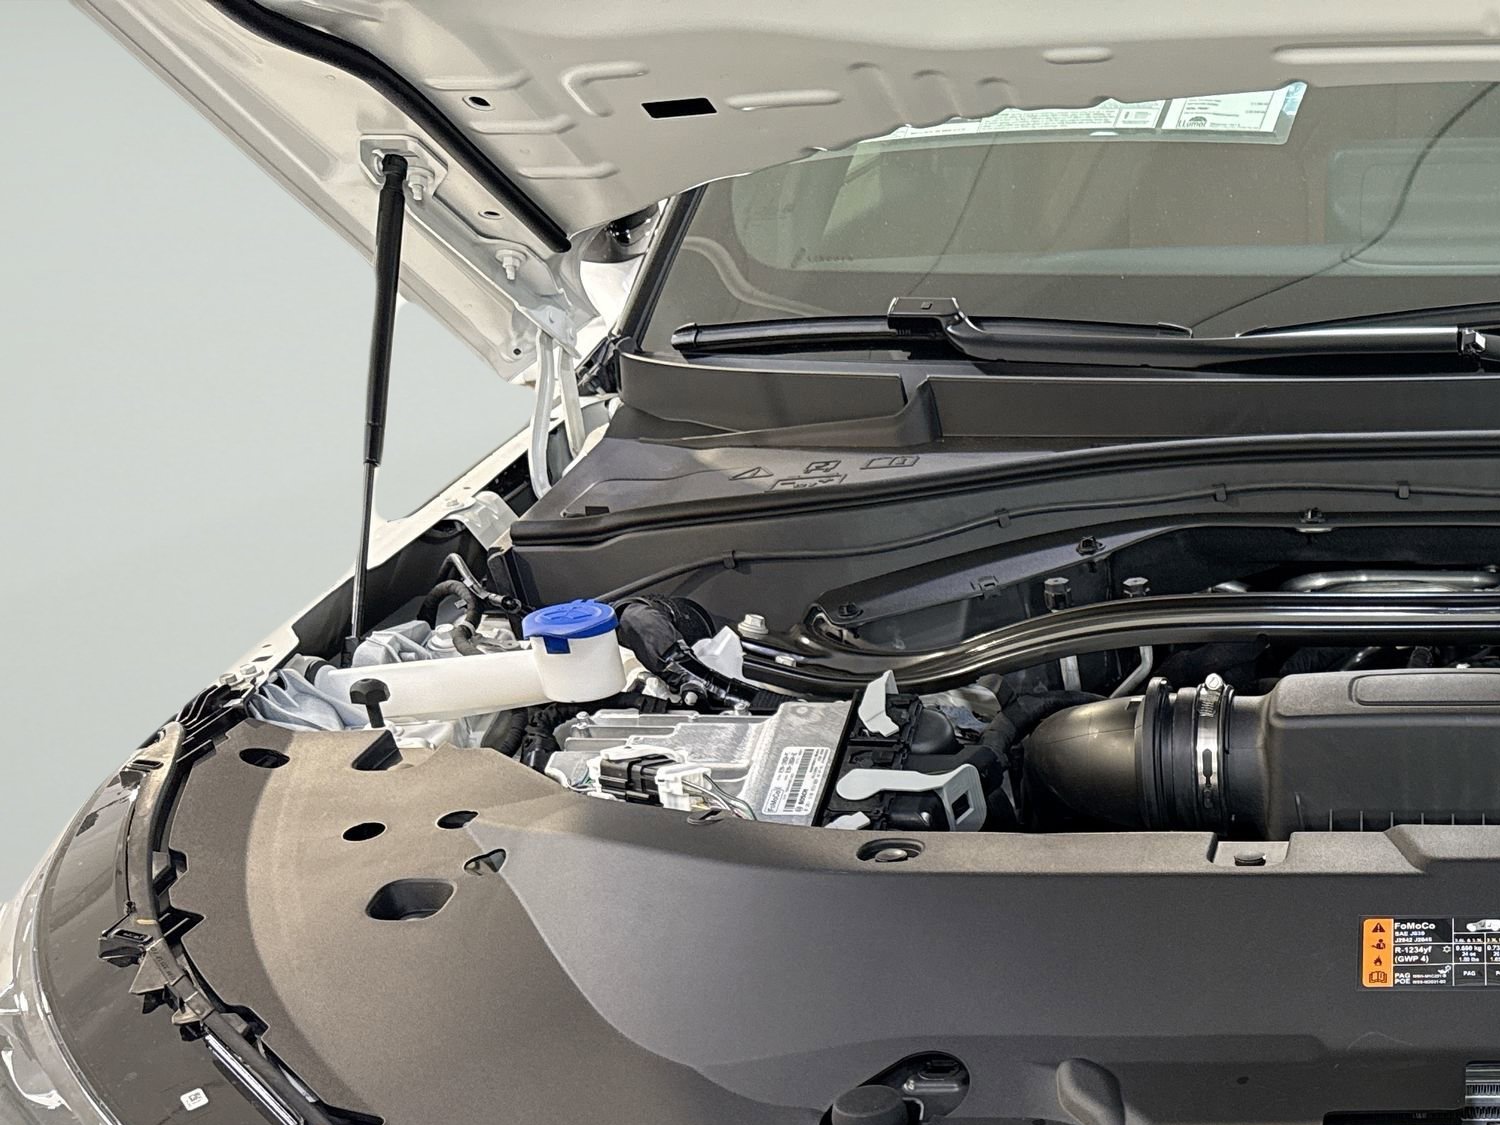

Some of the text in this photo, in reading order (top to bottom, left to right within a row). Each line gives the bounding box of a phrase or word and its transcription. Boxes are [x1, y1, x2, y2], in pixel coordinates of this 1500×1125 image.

[1394, 922, 1436, 930] FoMoCo
[1394, 945, 1433, 955] R-1234yf
[1394, 954, 1429, 963] (GWP 4)
